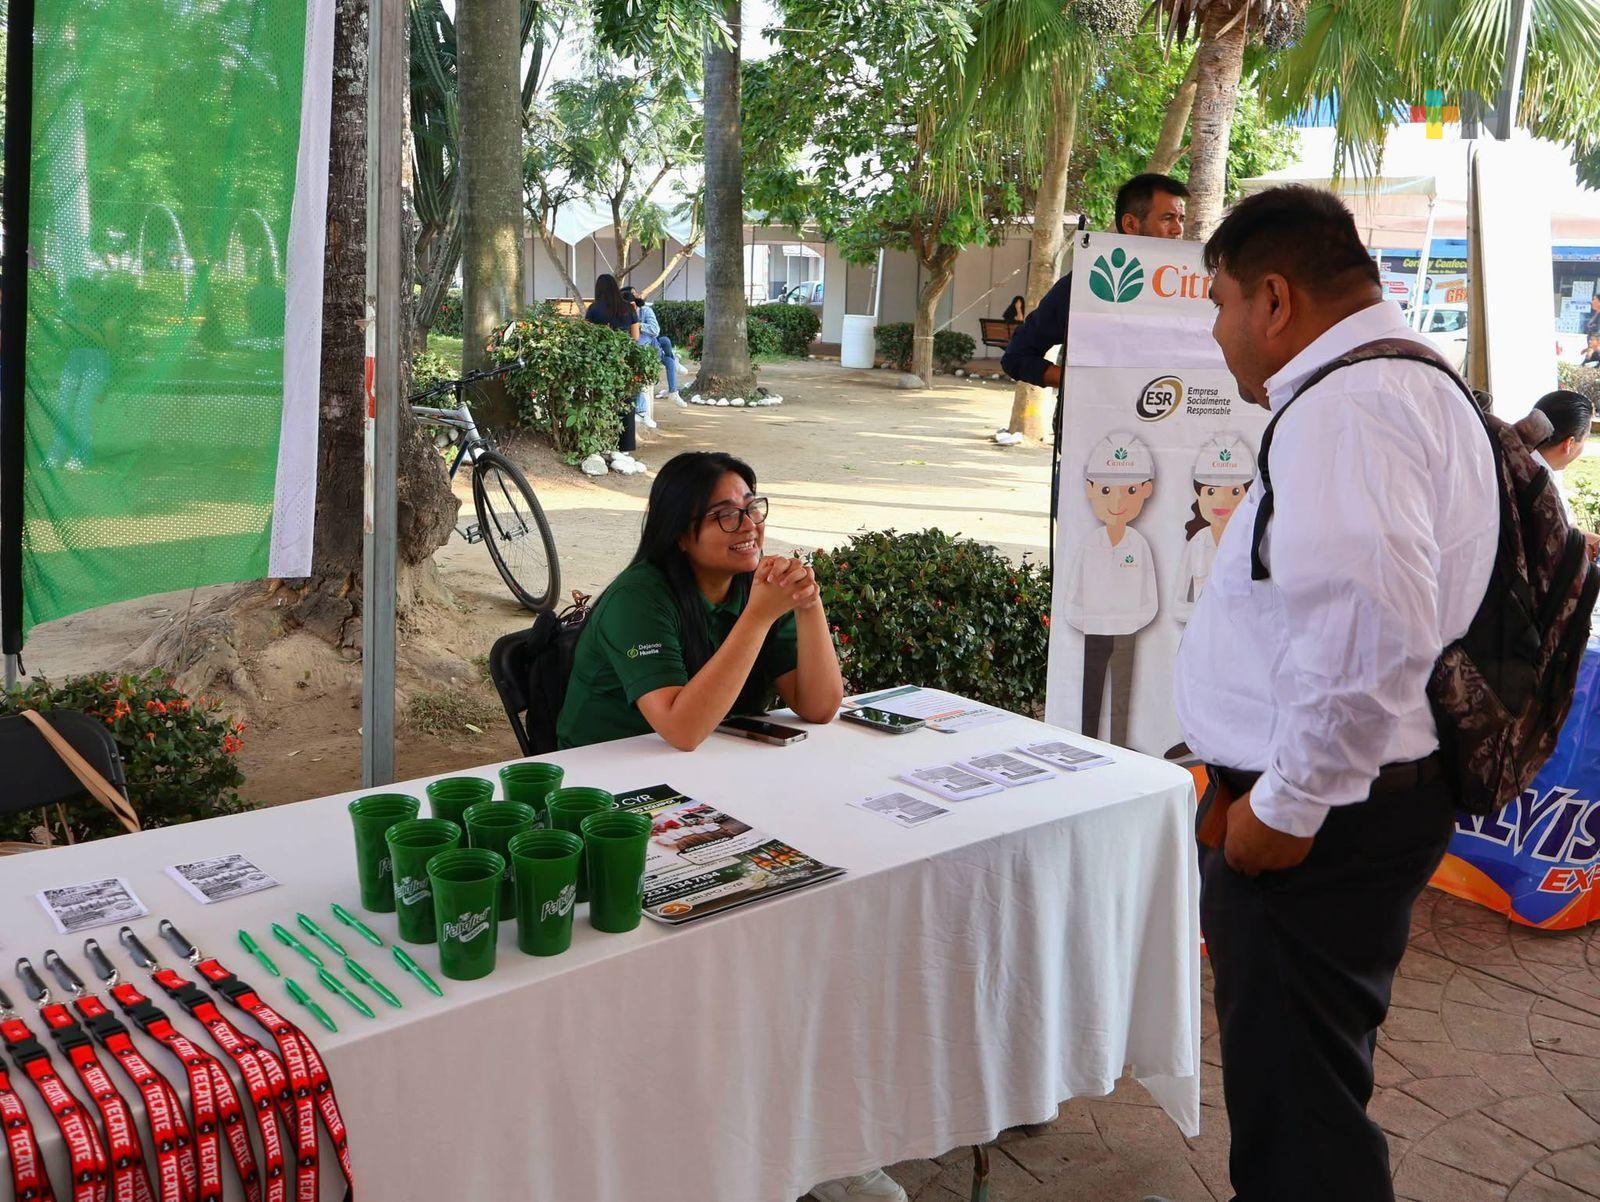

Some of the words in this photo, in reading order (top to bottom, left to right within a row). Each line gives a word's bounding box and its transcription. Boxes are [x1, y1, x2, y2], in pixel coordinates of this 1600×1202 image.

[1152, 264, 1211, 298] Citr
[1145, 392, 1172, 405] ESR
[1186, 406, 1231, 416] Responsable
[1187, 387, 1218, 396] Empresa
[1187, 397, 1231, 406] Socialmente
[622, 794, 654, 806] CYR
[213, 1021, 240, 1049] TECATE
[281, 1035, 307, 1079] TECATE
[192, 1066, 213, 1115] TECATE
[239, 1053, 266, 1091] TECATE
[104, 1099, 130, 1149] TECATE
[145, 1085, 171, 1132] TECATE
[300, 1100, 315, 1149] TECATE
[320, 1092, 343, 1135] TECATE
[11, 1129, 36, 1180] TECATE
[63, 1115, 92, 1162] TECATE
[230, 1124, 252, 1168] TECATE
[262, 1111, 281, 1159] TECATE
[201, 1136, 218, 1187] TECATE
